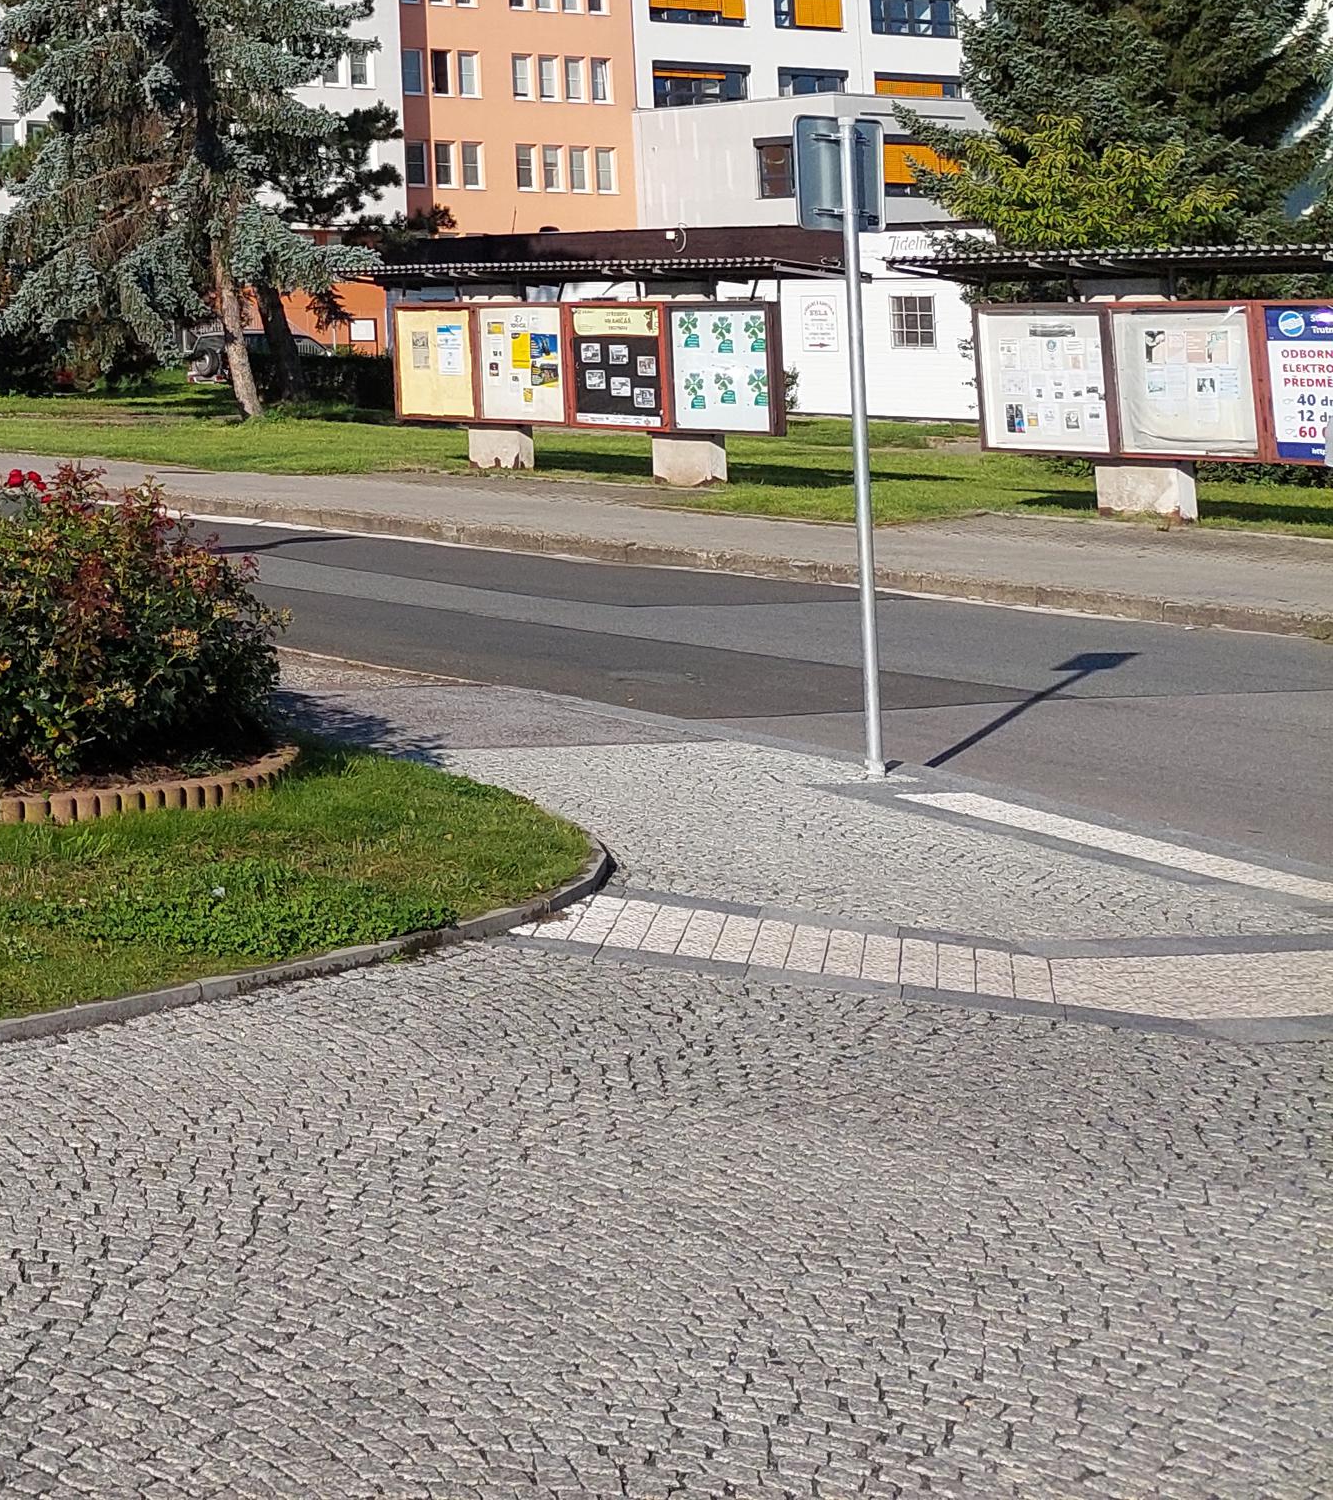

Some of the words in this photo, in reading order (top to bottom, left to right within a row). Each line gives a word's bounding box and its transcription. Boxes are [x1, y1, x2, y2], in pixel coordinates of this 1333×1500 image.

[1297, 394, 1316, 406] 40
[1298, 410, 1315, 421] 12
[1299, 426, 1317, 438] 60
